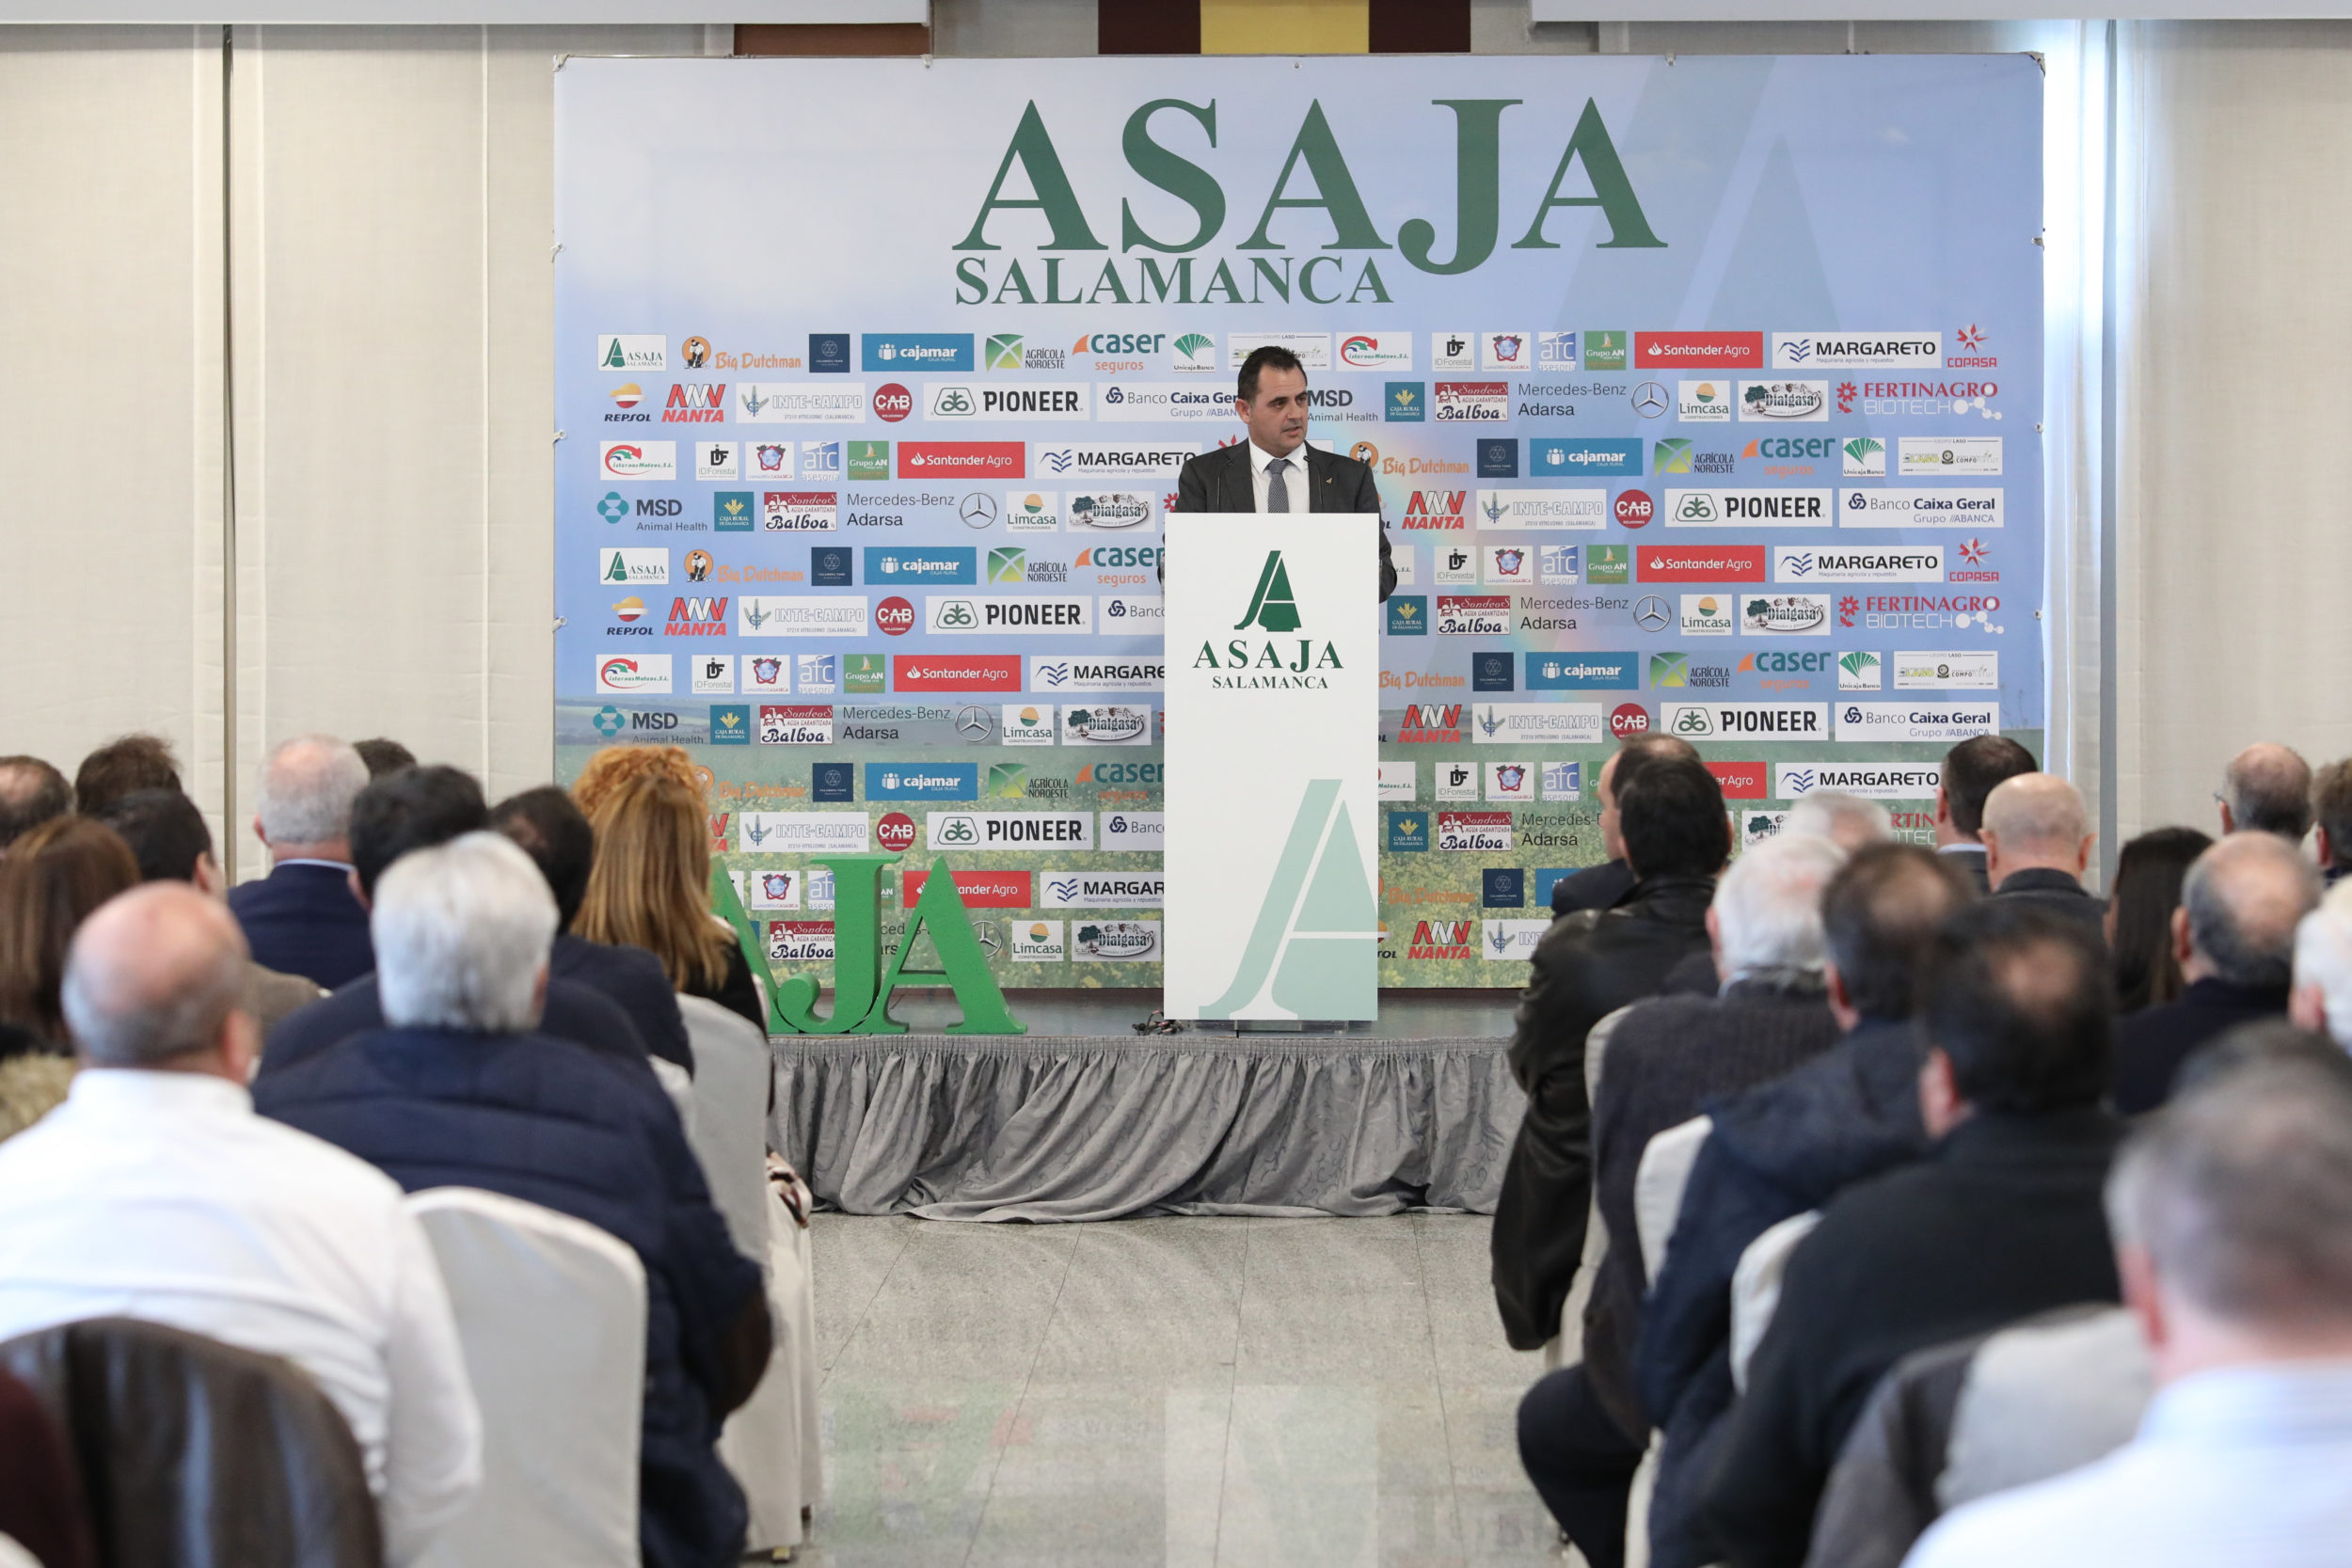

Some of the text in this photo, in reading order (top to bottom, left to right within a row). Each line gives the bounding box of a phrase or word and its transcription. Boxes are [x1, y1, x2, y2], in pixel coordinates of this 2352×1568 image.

[952, 97, 1668, 275] ASAJA
[955, 256, 1393, 305] SALAMANCA
[1091, 334, 1166, 354] caser
[1540, 333, 1574, 359] afc
[1664, 344, 1750, 357] Santander Agro
[1816, 341, 1936, 356] MARGARETO
[627, 352, 662, 361] ASAJA
[900, 345, 958, 361] cajamar
[1025, 348, 1065, 359] AGRÍCOLA
[715, 352, 738, 371] Big
[741, 353, 802, 369] Dutchman
[1025, 359, 1065, 369] NOROESTE
[1095, 361, 1144, 373] seguros
[1947, 357, 1997, 368] COPASA
[1518, 383, 1627, 396] Mercedes-Benz
[1864, 382, 1998, 397] FERTINAGRO
[773, 395, 863, 409] INTE-CAMPO
[875, 394, 911, 408] CAB
[983, 391, 1079, 412] PIONEER
[1127, 391, 1210, 404] Banco Caixa
[1308, 389, 1353, 406] MSD
[1765, 393, 1814, 407] Dialgasa
[1170, 408, 1202, 419] Grupo
[1437, 404, 1500, 420] Balboa
[1518, 403, 1575, 416] Adarsa
[1680, 403, 1729, 414] Limcasa
[1864, 400, 1951, 415] BIOTECH
[661, 409, 724, 422] NANTA
[1308, 412, 1378, 421] Animal Health
[1761, 438, 1836, 457] caser
[803, 443, 837, 469] afc
[927, 454, 1012, 467] Santander Agro
[1569, 450, 1626, 466] cajamar
[1694, 451, 1734, 464] AGRÍCOLA
[1383, 457, 1406, 476] Big
[1409, 458, 1470, 474] Dutchman
[1694, 465, 1734, 474] NOROESTE
[1765, 465, 1814, 478] seguros
[847, 493, 955, 506] Mercedes-Benz
[1870, 498, 1994, 510] Banco Caixa Geral
[636, 499, 682, 516] MSD
[1092, 504, 1141, 518] Dialgasa
[1513, 500, 1603, 515] INTE-CAMPO
[1616, 500, 1652, 515] CAB
[1725, 497, 1821, 518] PIONEER
[636, 522, 707, 531] Animal Health
[766, 515, 829, 531] Balboa
[847, 513, 903, 526] Adarsa
[1008, 514, 1057, 525] Limcasa
[1402, 516, 1464, 530] NANTA
[1914, 515, 1946, 525] Grupo
[902, 559, 960, 575] cajamar
[1027, 561, 1067, 573] AGRÍCOLA
[1542, 547, 1576, 574] afc
[1666, 558, 1752, 571] Santander Agro
[1818, 555, 1938, 569] MARGARETO
[628, 565, 664, 575] ASAJA
[717, 565, 739, 584] Big
[743, 566, 803, 582] Dutchman
[1949, 572, 1999, 582] COPASA
[1027, 574, 1067, 583] NOROESTE
[1097, 574, 1146, 587] seguros
[1520, 596, 1629, 610] Mercedes-Benz
[1866, 596, 2000, 611] FERTINAGRO
[775, 608, 865, 622] INTE-CAMPO
[877, 608, 913, 623] CAB
[985, 604, 1081, 626] PIONEER
[1767, 608, 1816, 622] Dialgasa
[1866, 614, 1953, 629] BIOTECH
[663, 623, 726, 636] NANTA
[1438, 618, 1502, 634] Balboa
[1520, 616, 1577, 629] Adarsa
[1682, 617, 1731, 628] Limcasa
[606, 626, 653, 636] REPSOL
[1192, 640, 1343, 673] ASAJA
[1756, 652, 1831, 672] caser
[800, 657, 834, 683] afc
[923, 668, 1009, 681] Santander Agro
[1565, 663, 1622, 679] cajamar
[1691, 666, 1730, 677] AGRÍCOLA
[1212, 675, 1328, 689] SALAMANCA
[1378, 671, 1401, 689] Big
[1406, 672, 1464, 688] Dutchman
[1691, 677, 1730, 687] NOROESTE
[1760, 679, 1808, 691] seguros
[843, 706, 951, 720] Mercedes-Benz
[1867, 711, 1991, 723] Banco Caixa Geral
[632, 713, 678, 730] MSD
[1089, 718, 1137, 732] Dialgasa
[1509, 715, 1599, 729] INTE-CAMPO
[1612, 714, 1646, 728] CAB
[1721, 711, 1817, 732] PIONEER
[761, 728, 824, 743] Balboa
[843, 726, 899, 739] Adarsa
[1004, 726, 1053, 738] Limcasa
[1397, 730, 1460, 743] NANTA
[1909, 728, 1942, 738] Grupo
[632, 736, 704, 745] Animal Health
[904, 774, 961, 790] cajamar
[1029, 777, 1069, 788] AGRÍCOLA
[1727, 775, 1753, 788] Agro
[1820, 772, 1940, 786] MARGARETO
[1029, 788, 1069, 798] NOROESTE
[775, 824, 866, 838] INTE-CAMPO
[879, 823, 914, 837] CAB
[987, 820, 1083, 841] PIONEER
[1440, 834, 1503, 850] Balboa
[1522, 832, 1579, 846] Adarsa
[993, 884, 1018, 897] Agro
[1098, 933, 1147, 947] Dialgasa
[771, 943, 834, 959] Balboa
[1013, 942, 1062, 954] Limcasa
[1407, 946, 1470, 959] NANTA
